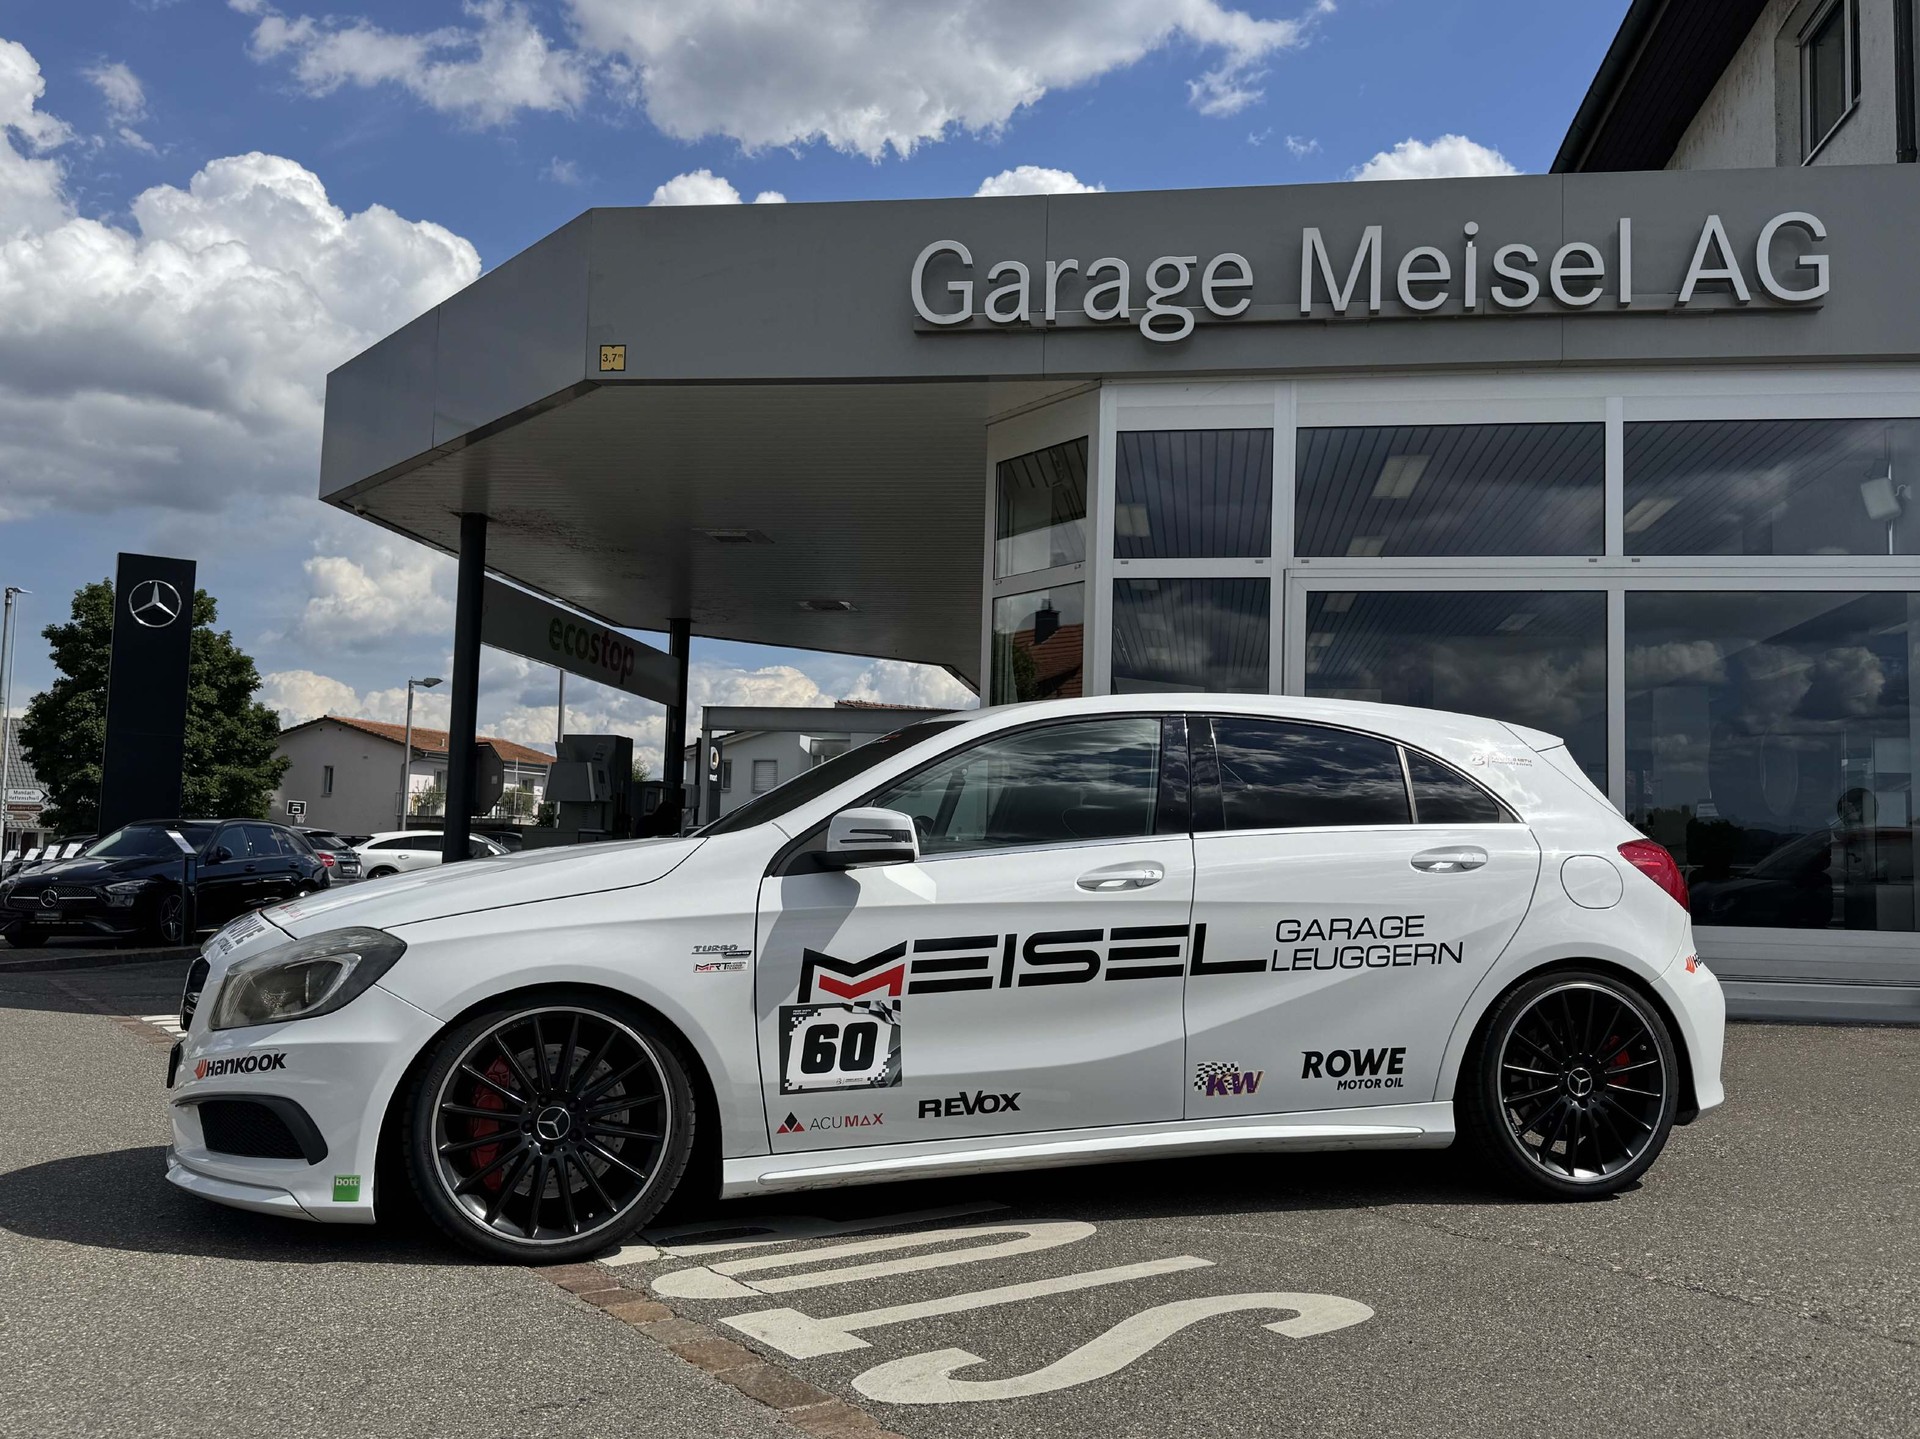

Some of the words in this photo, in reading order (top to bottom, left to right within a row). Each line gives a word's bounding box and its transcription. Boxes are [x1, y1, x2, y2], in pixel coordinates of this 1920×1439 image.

[911, 239, 1254, 342] Garage
[1299, 218, 1632, 314] Meisel
[1677, 211, 1830, 306] AG
[548, 616, 635, 684] ecostop
[1276, 915, 1425, 943] GARAGE
[796, 922, 1268, 1004] MEISEL
[1271, 942, 1464, 972] LEUGGERN
[800, 1021, 879, 1075] 60
[1301, 1047, 1407, 1080] ROWE
[1206, 1070, 1265, 1097] KW
[1336, 1079, 1382, 1091] MOTOR
[1384, 1078, 1404, 1089] OIL
[809, 1112, 884, 1132] ACUMAX
[335, 1177, 360, 1187] bott
